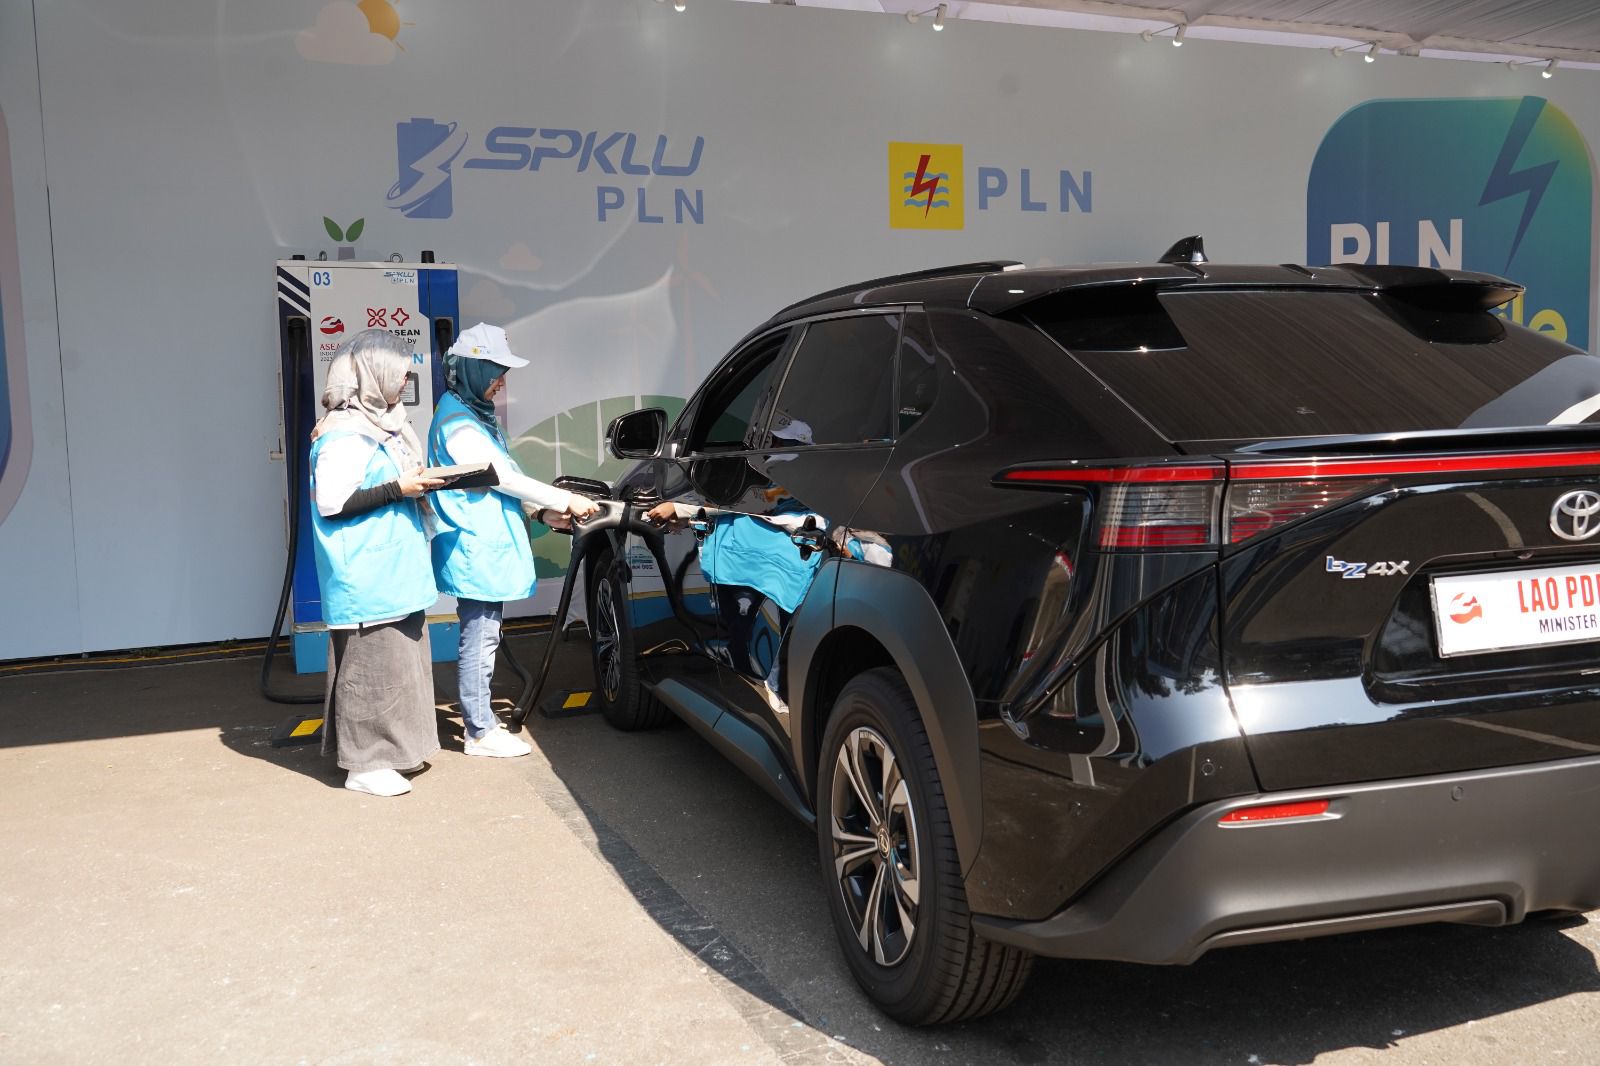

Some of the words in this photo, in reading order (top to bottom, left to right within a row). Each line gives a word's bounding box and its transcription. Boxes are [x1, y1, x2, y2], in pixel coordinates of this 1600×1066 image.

[463, 126, 705, 177] SPKLU
[597, 185, 704, 224] PLN
[978, 166, 1092, 213] PLN
[314, 271, 330, 286] 03
[319, 343, 341, 351] ASEA
[1517, 576, 1559, 613] LAO
[1539, 614, 1597, 634] MINISTER
